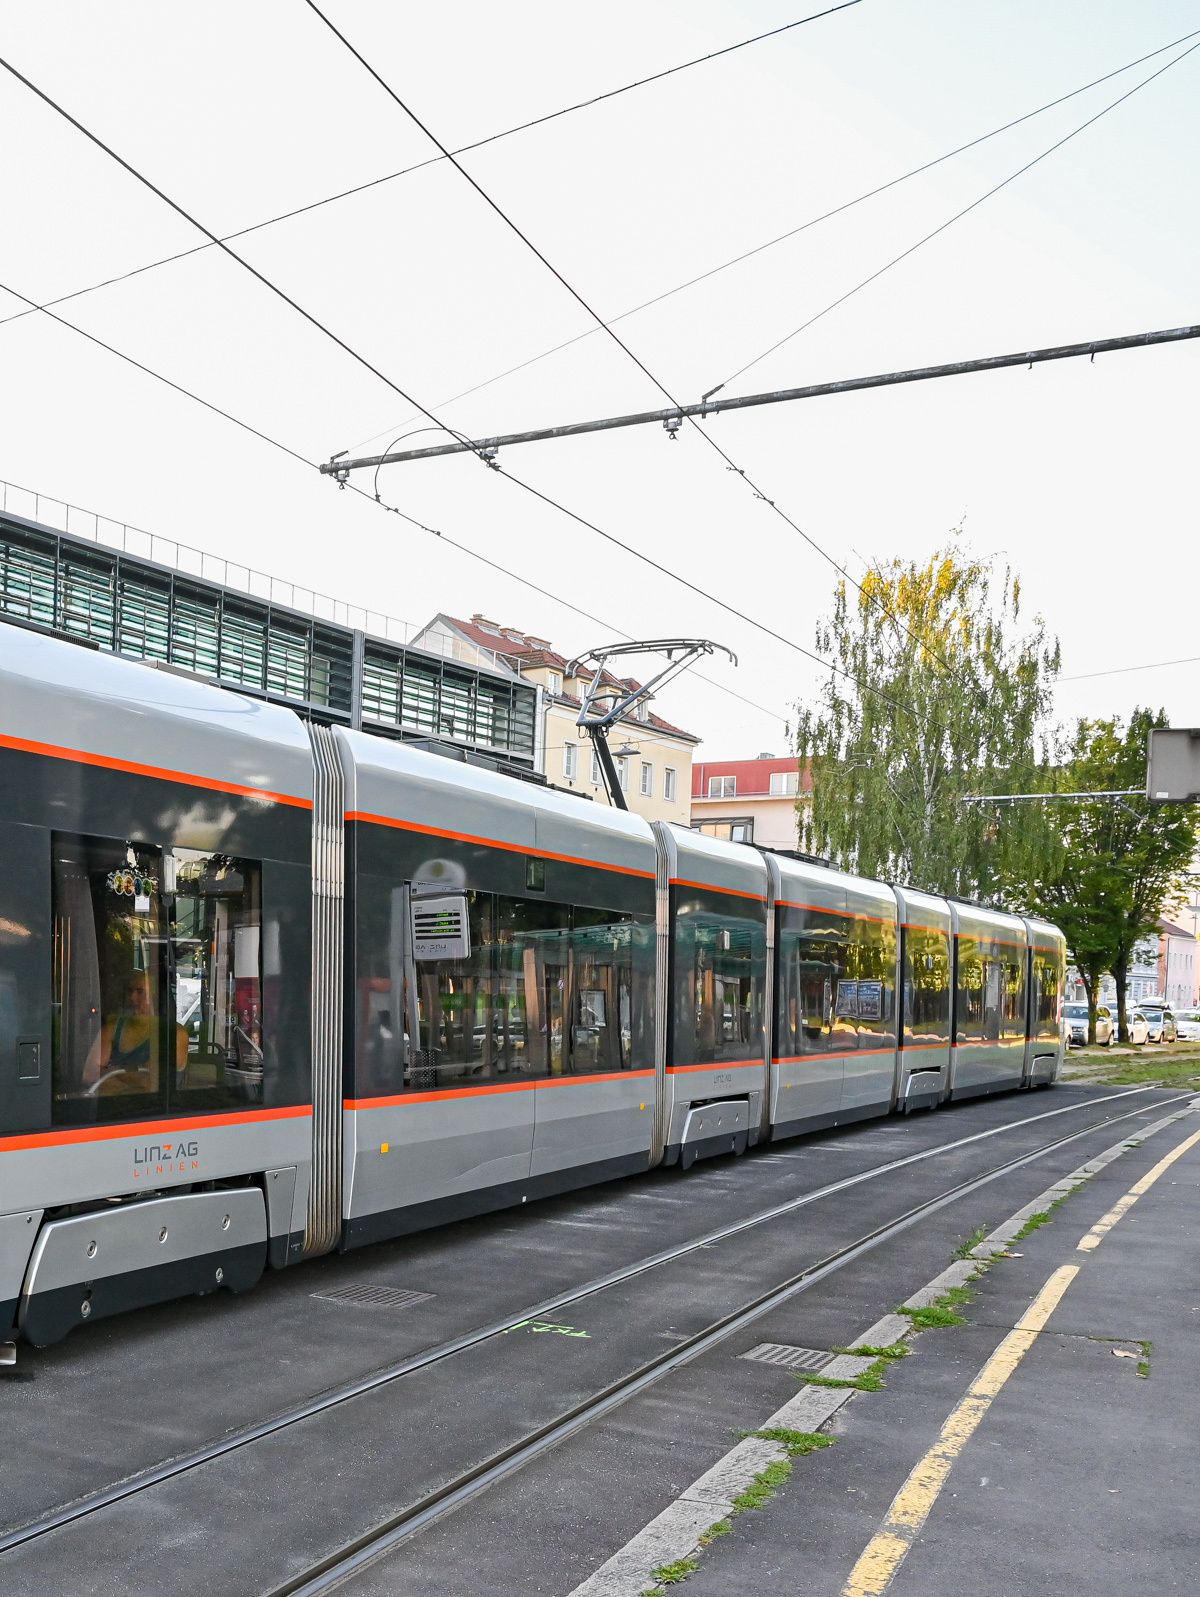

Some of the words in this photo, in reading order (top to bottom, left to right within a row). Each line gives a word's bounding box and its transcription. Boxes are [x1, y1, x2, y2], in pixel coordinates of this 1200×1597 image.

[134, 1144, 174, 1164] LINZ
[175, 1141, 198, 1159] AG
[133, 1160, 199, 1178] LINIEN
